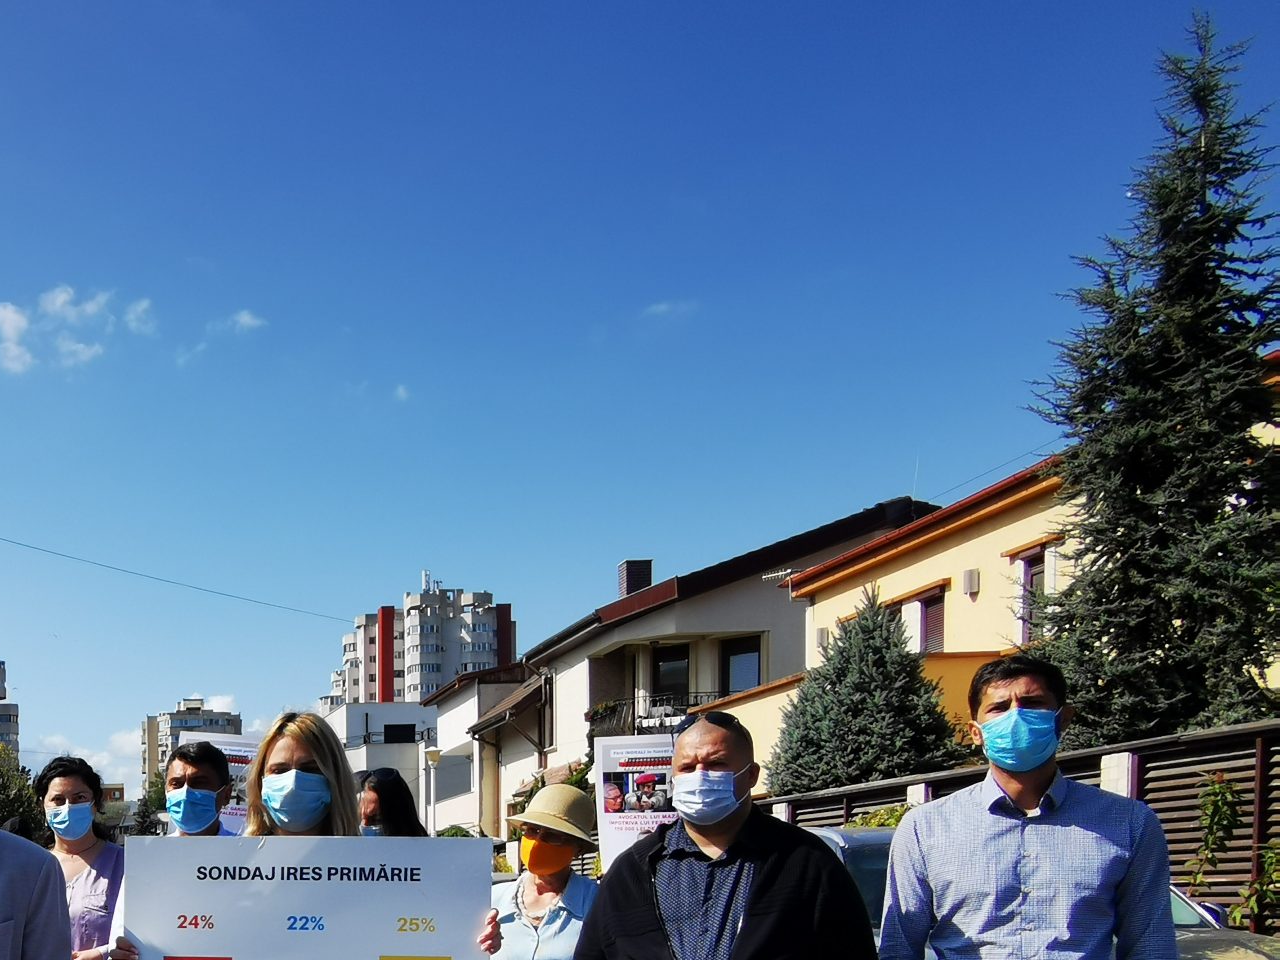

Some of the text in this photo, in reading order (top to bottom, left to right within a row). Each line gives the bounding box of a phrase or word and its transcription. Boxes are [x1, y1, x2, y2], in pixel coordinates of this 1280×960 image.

[196, 863, 421, 882] SONDAJ IRES PRIMĂRIE
[176, 914, 214, 930] 24%
[286, 915, 325, 931] 22%
[396, 917, 436, 933] 25%
